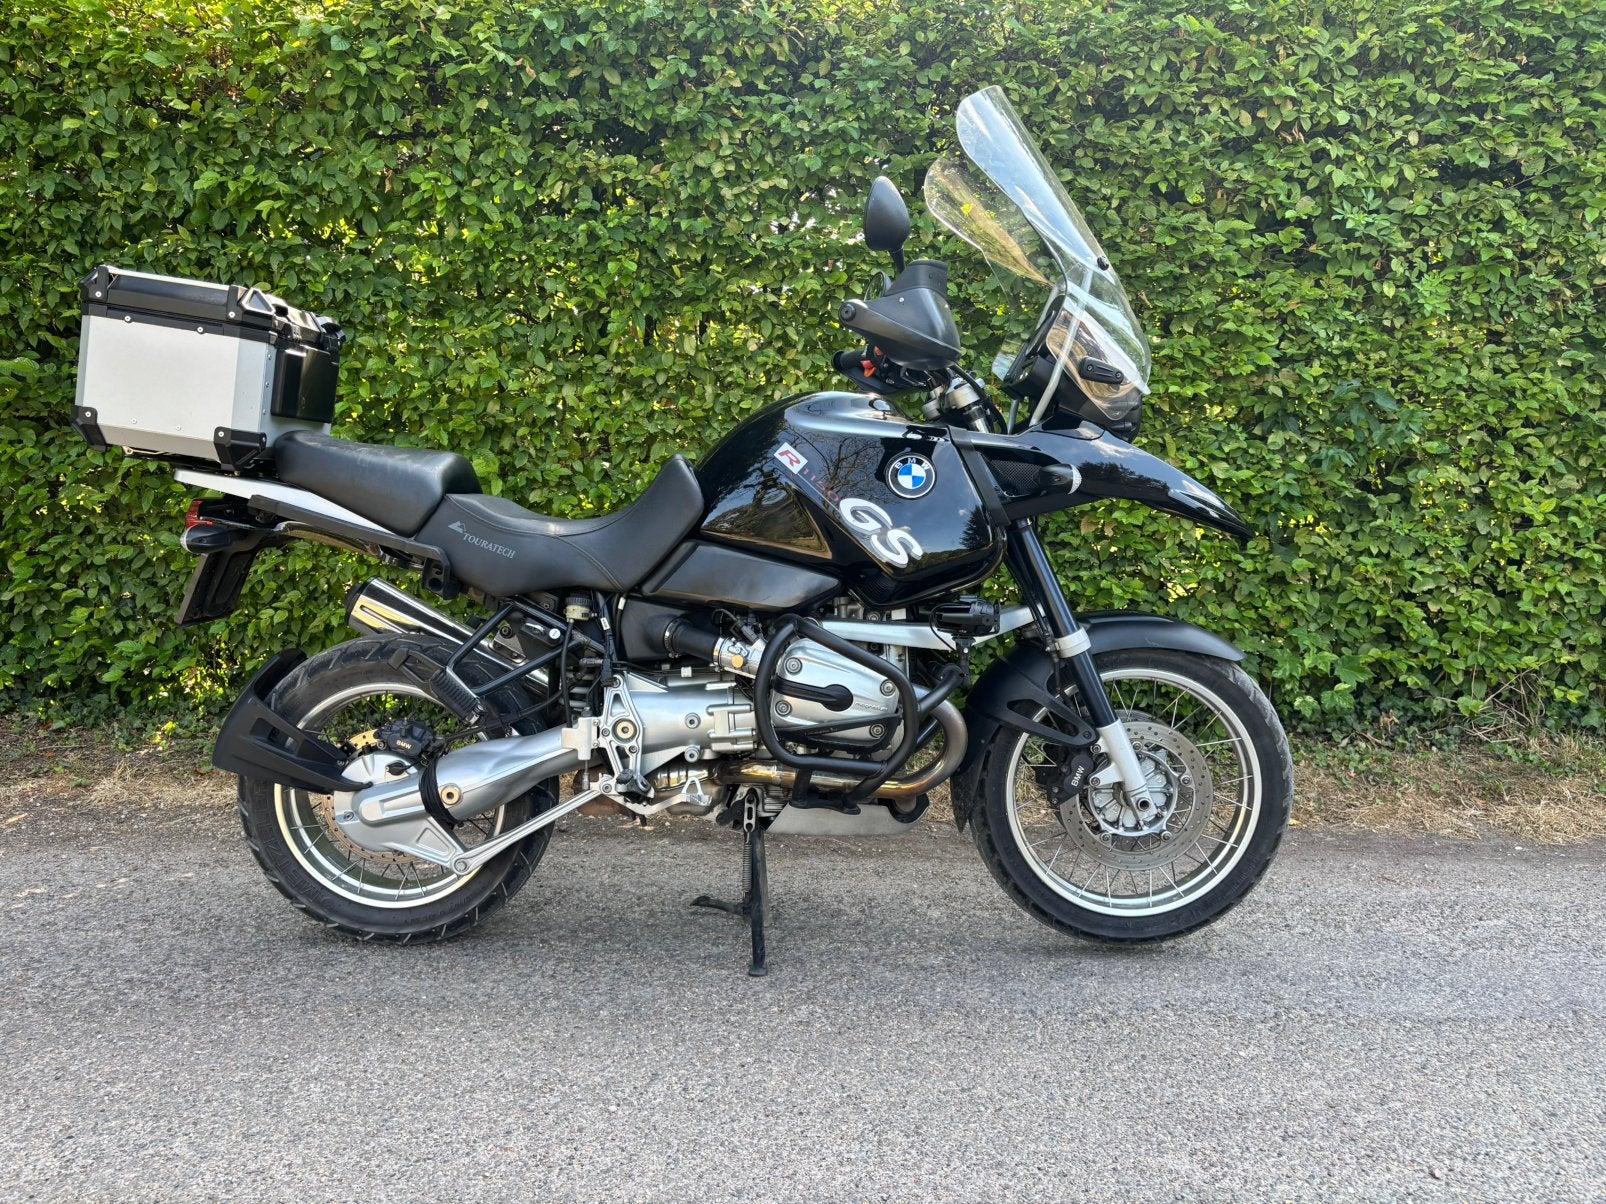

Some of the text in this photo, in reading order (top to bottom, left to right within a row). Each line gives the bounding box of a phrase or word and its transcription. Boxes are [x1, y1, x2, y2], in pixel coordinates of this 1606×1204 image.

[894, 457, 930, 471] BMW
[778, 449, 801, 467] R
[839, 497, 924, 568] GS
[463, 532, 516, 559] TOURATECH
[396, 739, 412, 749] BMW
[1071, 765, 1085, 787] BMW
